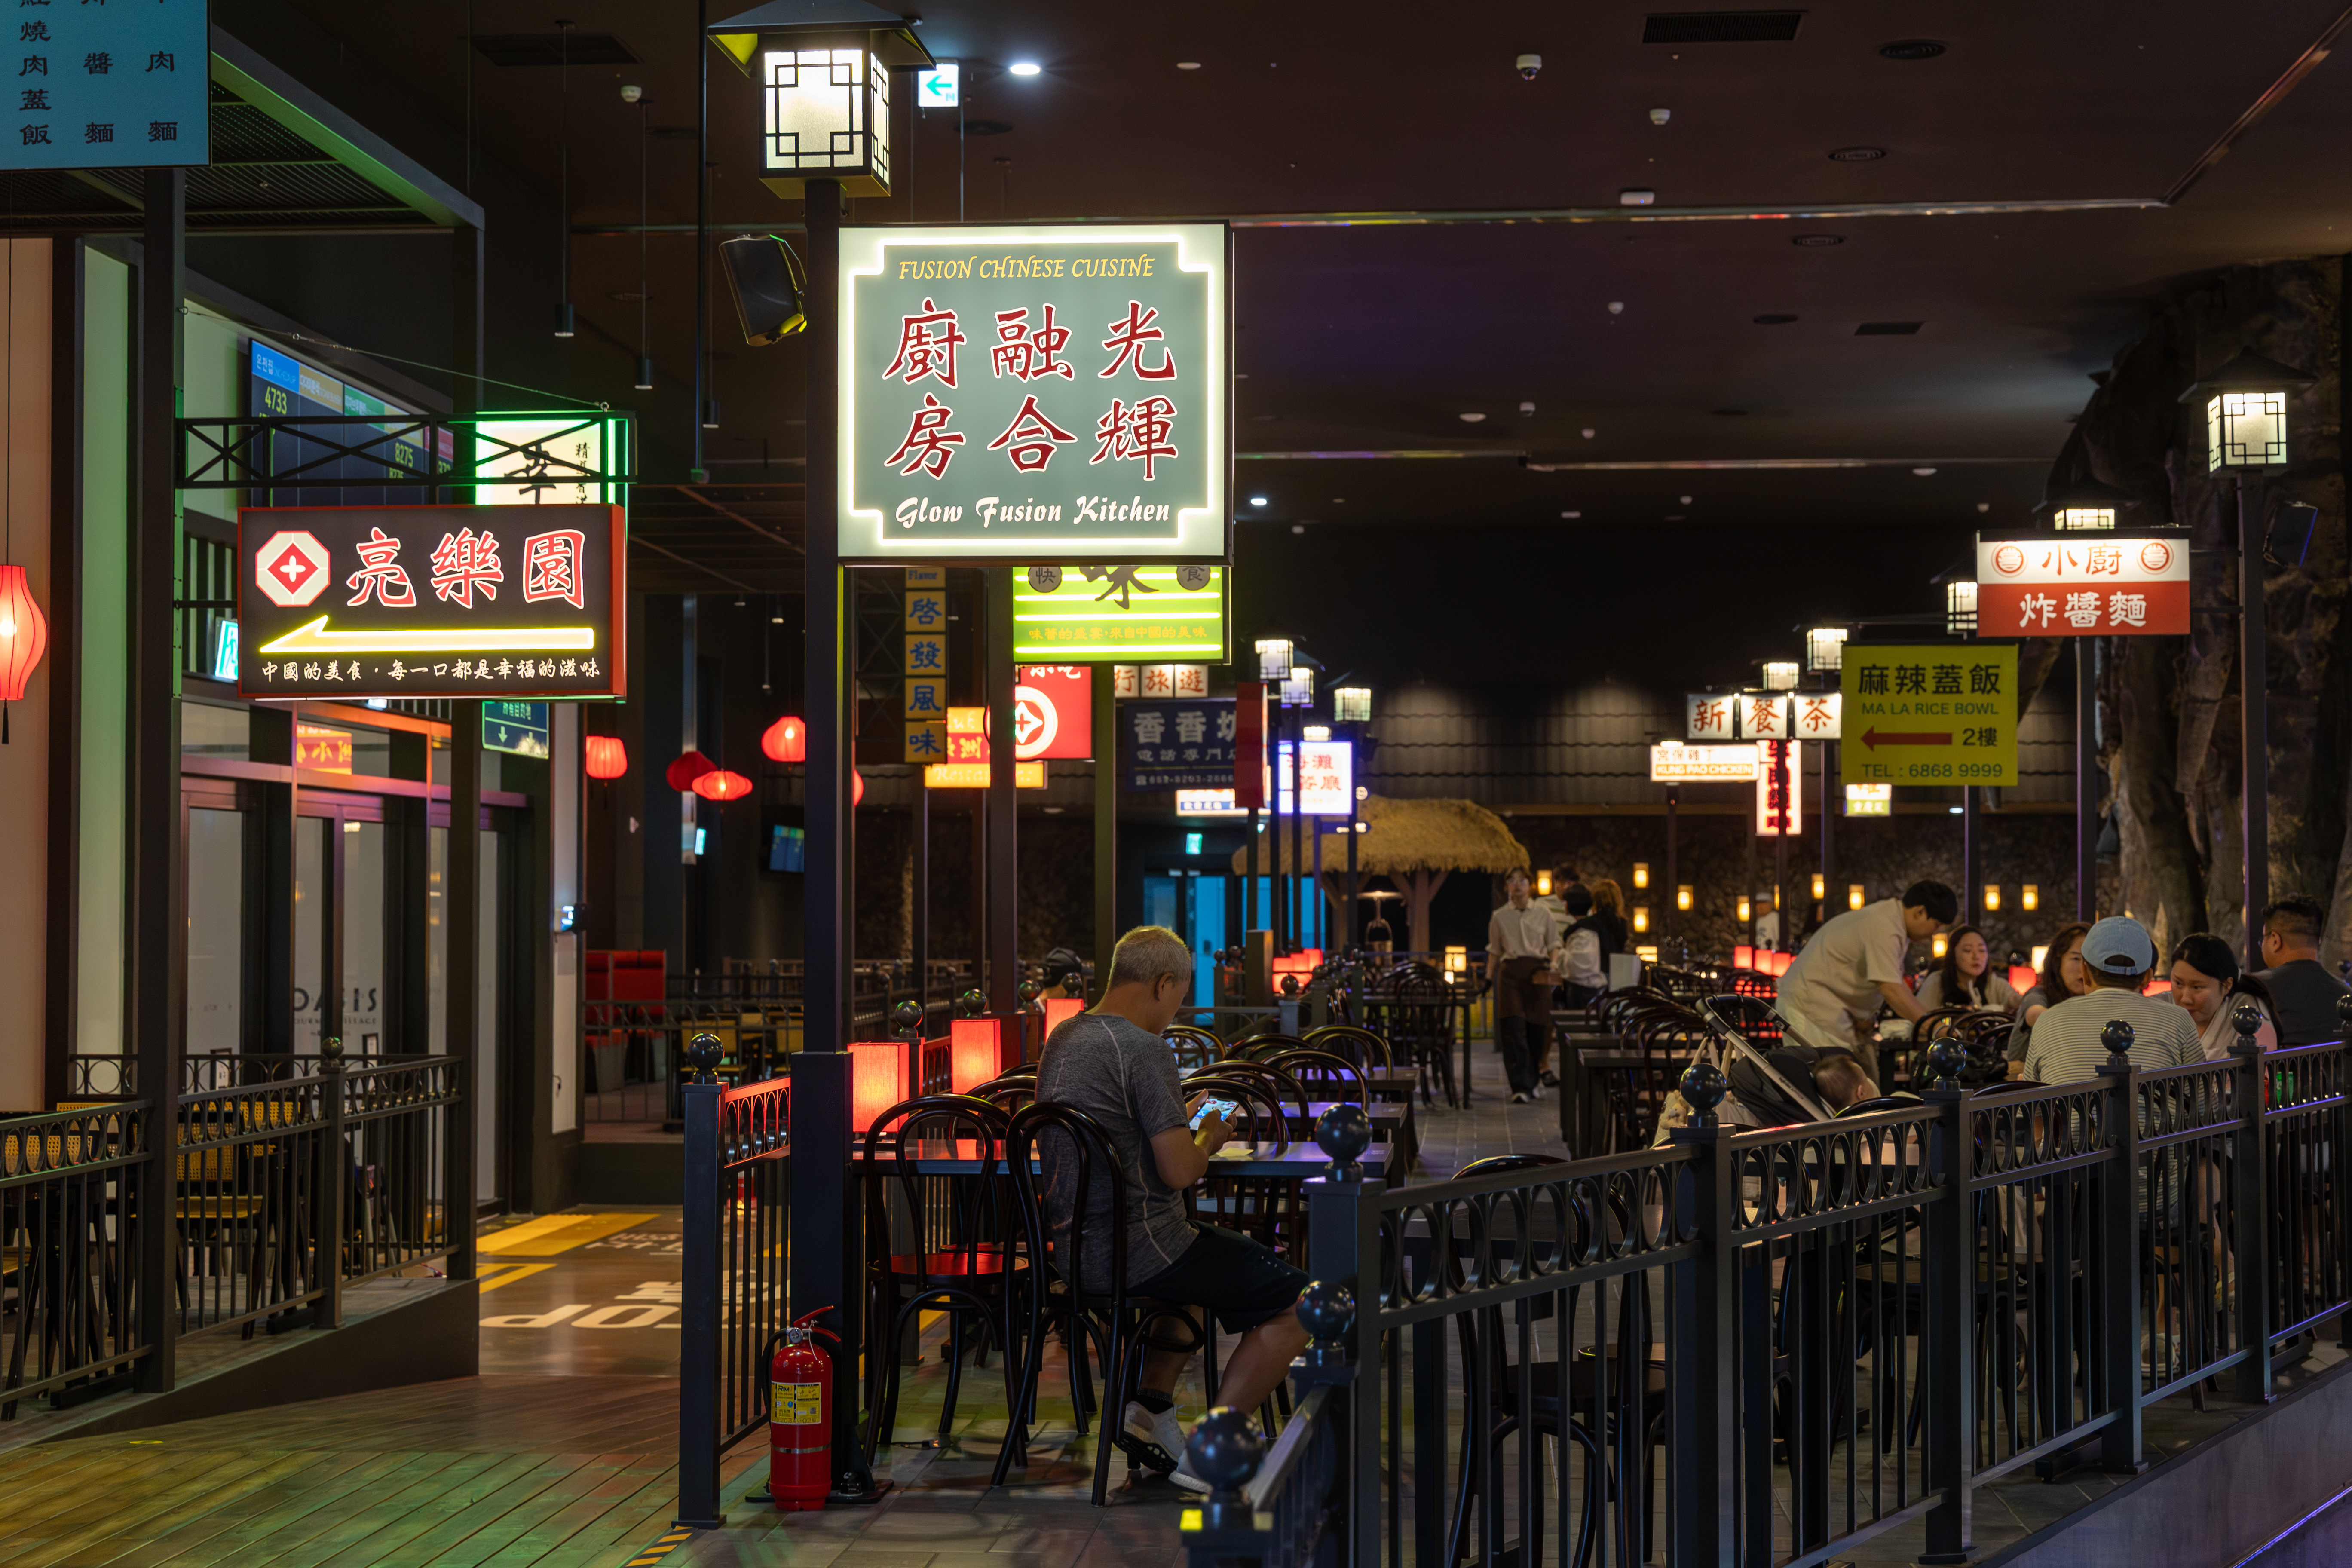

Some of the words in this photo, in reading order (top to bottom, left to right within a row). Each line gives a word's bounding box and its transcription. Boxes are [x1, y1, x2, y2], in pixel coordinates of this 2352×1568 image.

[81, 0, 114, 144] 醬麵
[145, 0, 178, 142] 肉麵
[899, 256, 978, 279] FUSION
[979, 255, 1066, 278] CHINESE
[1072, 254, 1155, 277] CUISINE
[265, 386, 287, 415] 4733
[395, 442, 413, 469] 8275
[896, 497, 963, 529] Glow
[975, 496, 1062, 528] Fusion
[1073, 496, 1170, 524] Kitchen
[346, 527, 586, 609] 亮樂園
[2019, 591, 2148, 628] 炸醬麵
[1858, 663, 2001, 696] 麻辣蓋飯
[1862, 703, 1886, 715] MA
[1891, 703, 1911, 715] LA
[1915, 703, 1949, 715] RICE
[1954, 703, 2000, 715] BOWL
[1962, 727, 1998, 748] 2樓
[1687, 764, 1708, 774] PAO
[1862, 764, 1894, 778] TEL
[1909, 764, 1953, 778] 6868
[1958, 763, 2003, 778] 9999
[294, 987, 376, 1011] OIS
